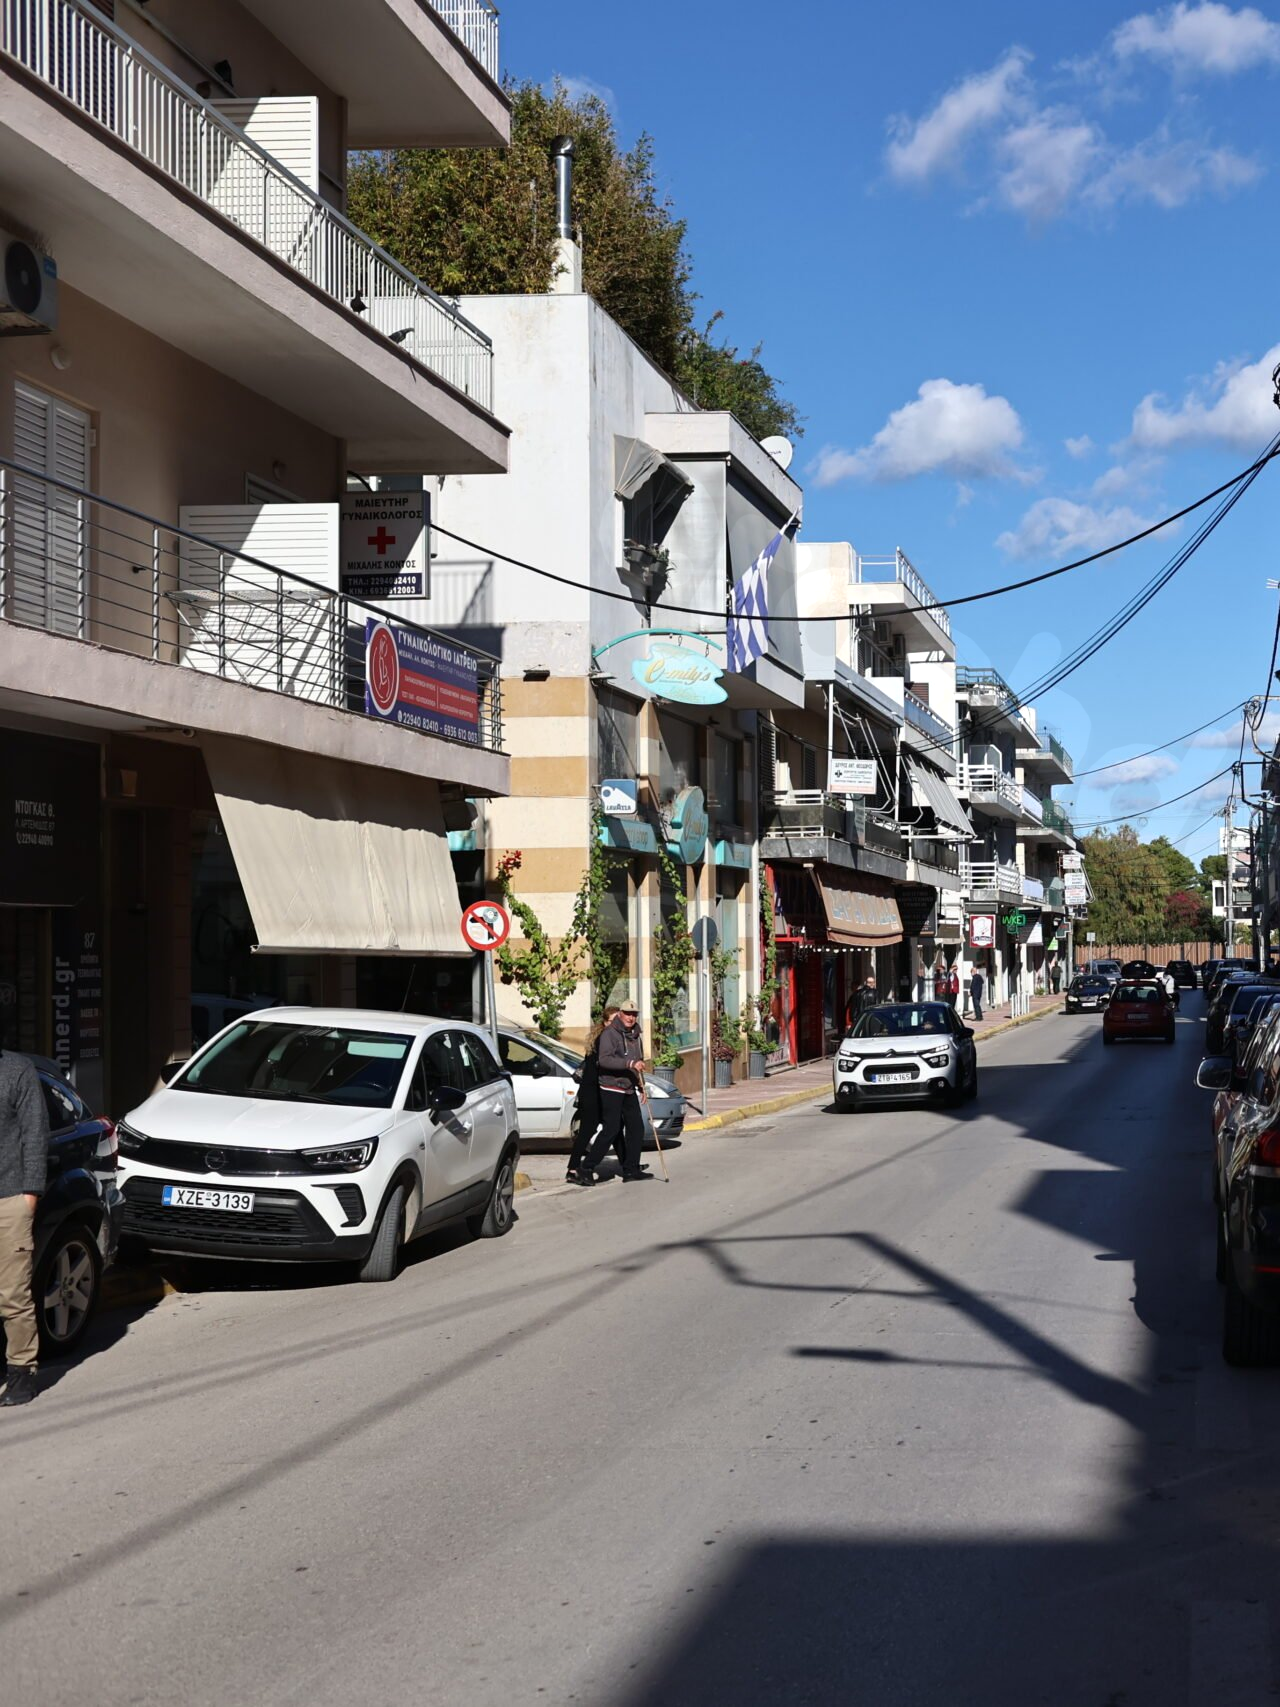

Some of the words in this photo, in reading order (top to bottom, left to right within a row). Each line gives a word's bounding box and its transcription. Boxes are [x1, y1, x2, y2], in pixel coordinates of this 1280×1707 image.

[355, 498, 409, 508] ΜΑΙΕΥΤΗΡ
[342, 510, 423, 521] ΓΥΝΑΙΚΟΛΟΓΟΣ
[347, 560, 383, 570] ΜΙΧΑΛΗΣ
[176, 1189, 251, 1210] XZE-3139
